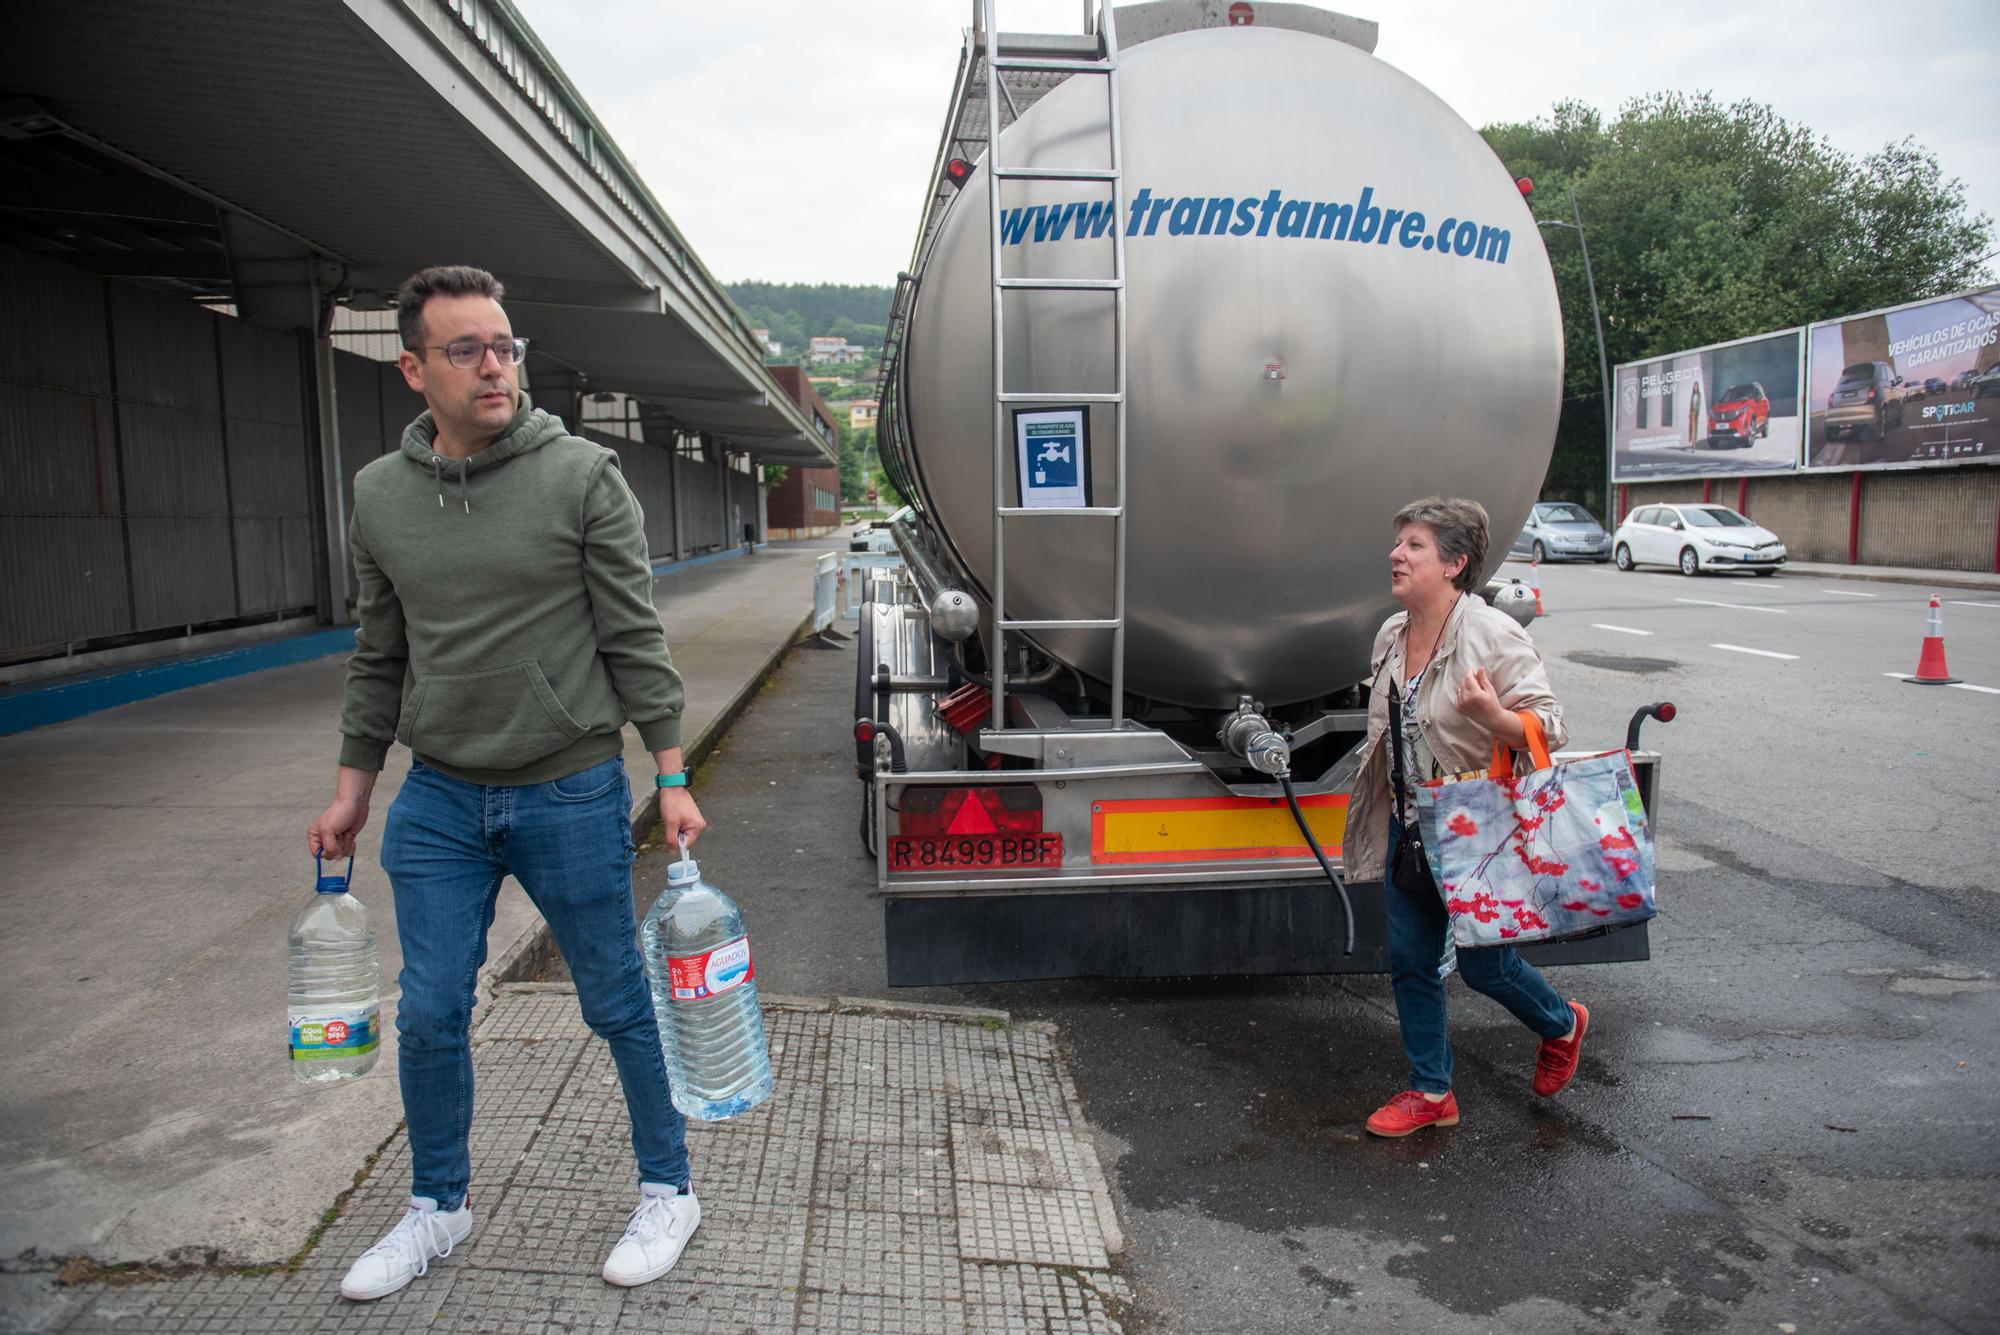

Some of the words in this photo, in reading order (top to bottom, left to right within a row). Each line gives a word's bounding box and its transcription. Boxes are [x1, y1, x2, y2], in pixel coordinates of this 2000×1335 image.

[1000, 187, 1511, 264] www.transtambre.com
[1888, 328, 1949, 357] VEHÍCULOS
[1950, 322, 1966, 338] DE
[1908, 329, 1998, 367] GARANTIZADOS
[1641, 367, 1699, 387] PEUGEOT
[1642, 385, 1661, 398] GAMA
[895, 842, 912, 866] R
[920, 839, 994, 866] 8499
[1001, 838, 1056, 865] BBF
